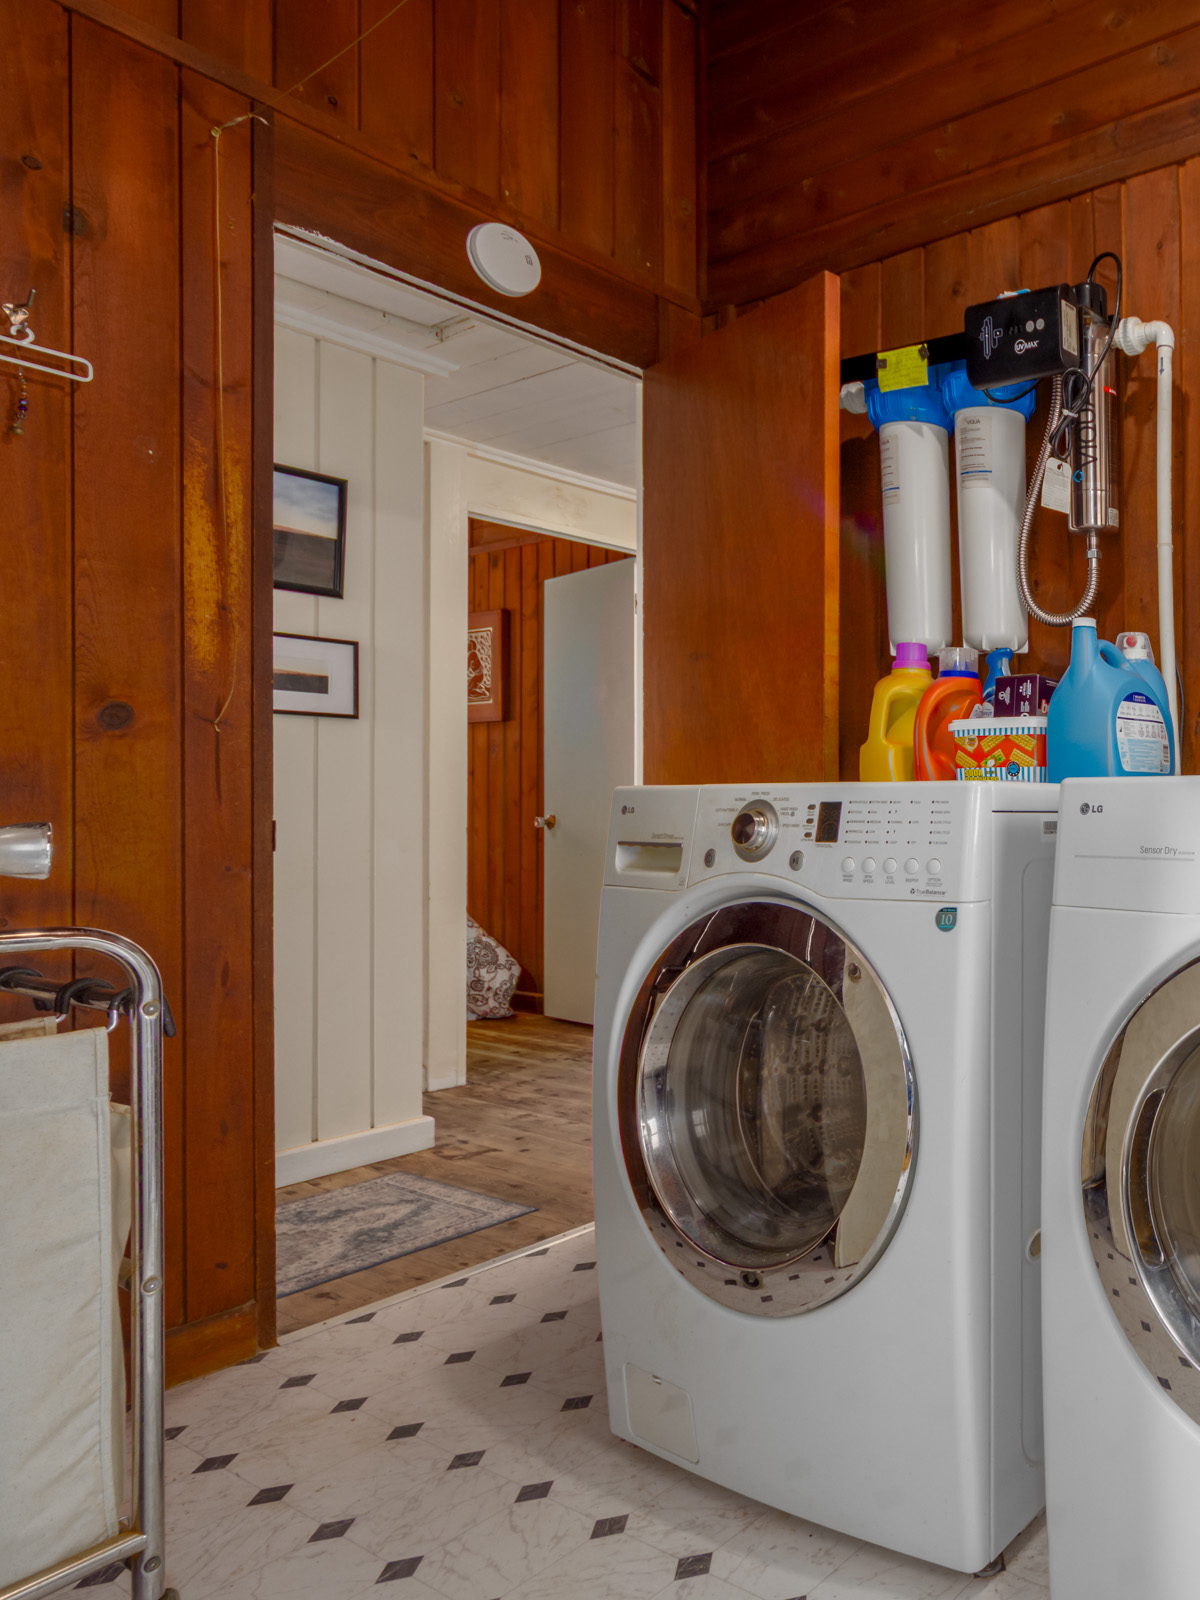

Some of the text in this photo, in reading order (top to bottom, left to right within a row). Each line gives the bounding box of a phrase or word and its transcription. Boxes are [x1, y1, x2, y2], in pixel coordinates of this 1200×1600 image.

[964, 769, 983, 777] SODA
[1091, 804, 1104, 814] LG
[1139, 845, 1163, 855] Sensor
[1164, 846, 1178, 856] Dry
[940, 913, 953, 925] 10
